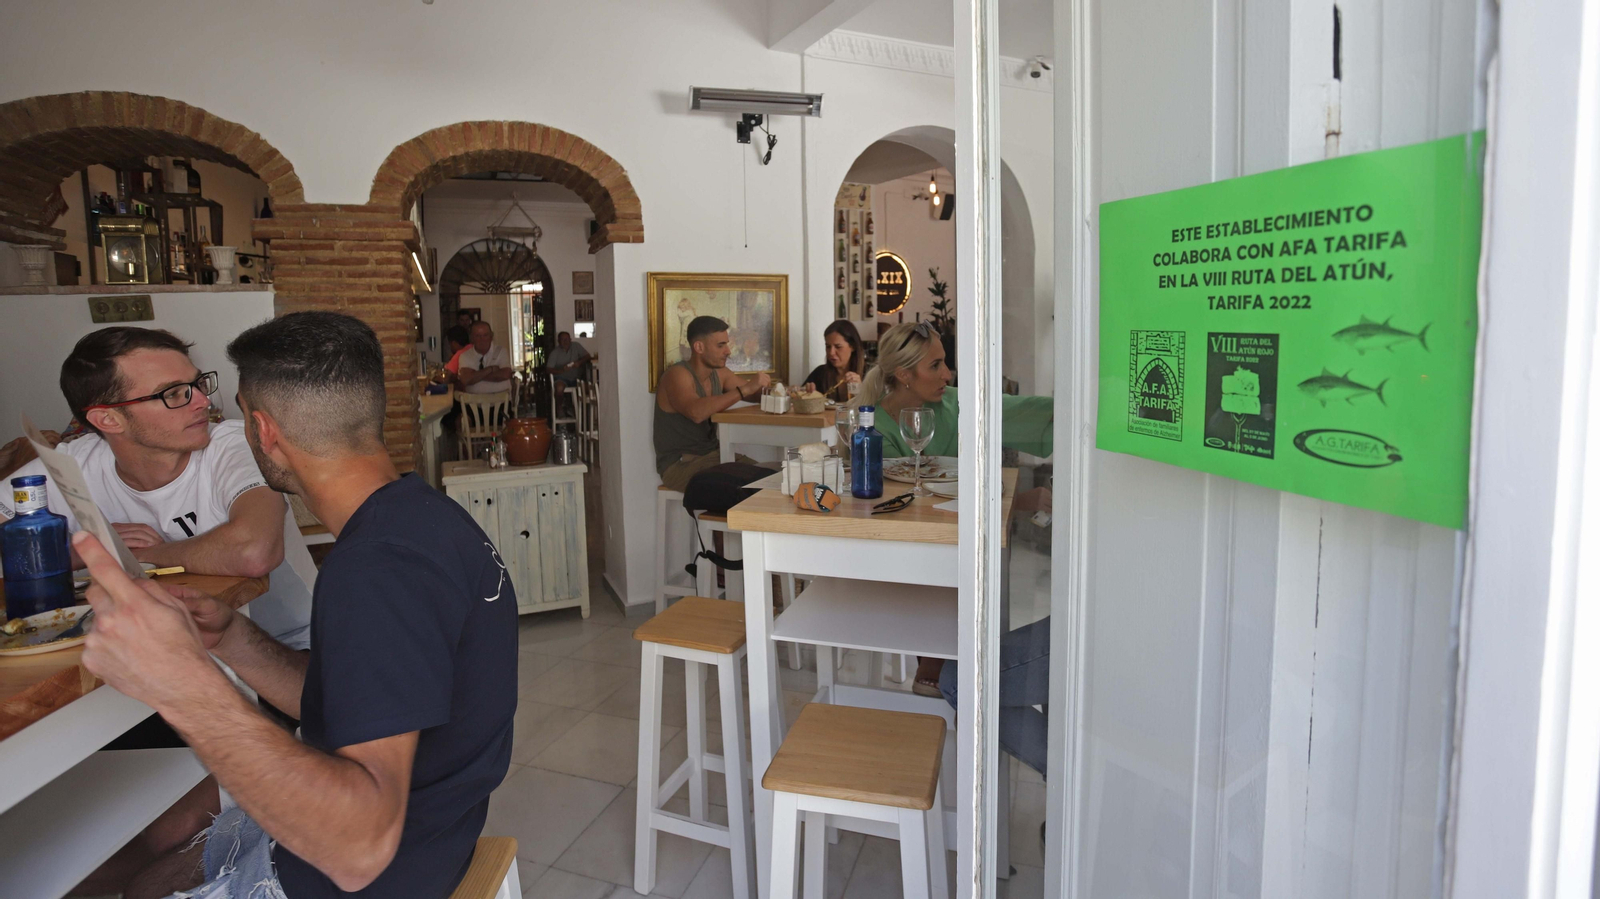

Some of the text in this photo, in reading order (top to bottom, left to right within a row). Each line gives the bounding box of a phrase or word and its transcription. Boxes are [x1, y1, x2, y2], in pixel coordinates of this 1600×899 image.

[1171, 204, 1374, 243] ESTE ESTABLECIMIENTO
[1153, 230, 1408, 267] COLABORA CON AFA TARIFA
[877, 271, 903, 284] XIX
[1158, 258, 1394, 288] EN LA VIII RUTA DEL ATÚN,
[1207, 295, 1312, 310] TARIFA 2022
[1211, 334, 1273, 353] VIII RUTA DEL
[1138, 396, 1174, 410] TARIFA
